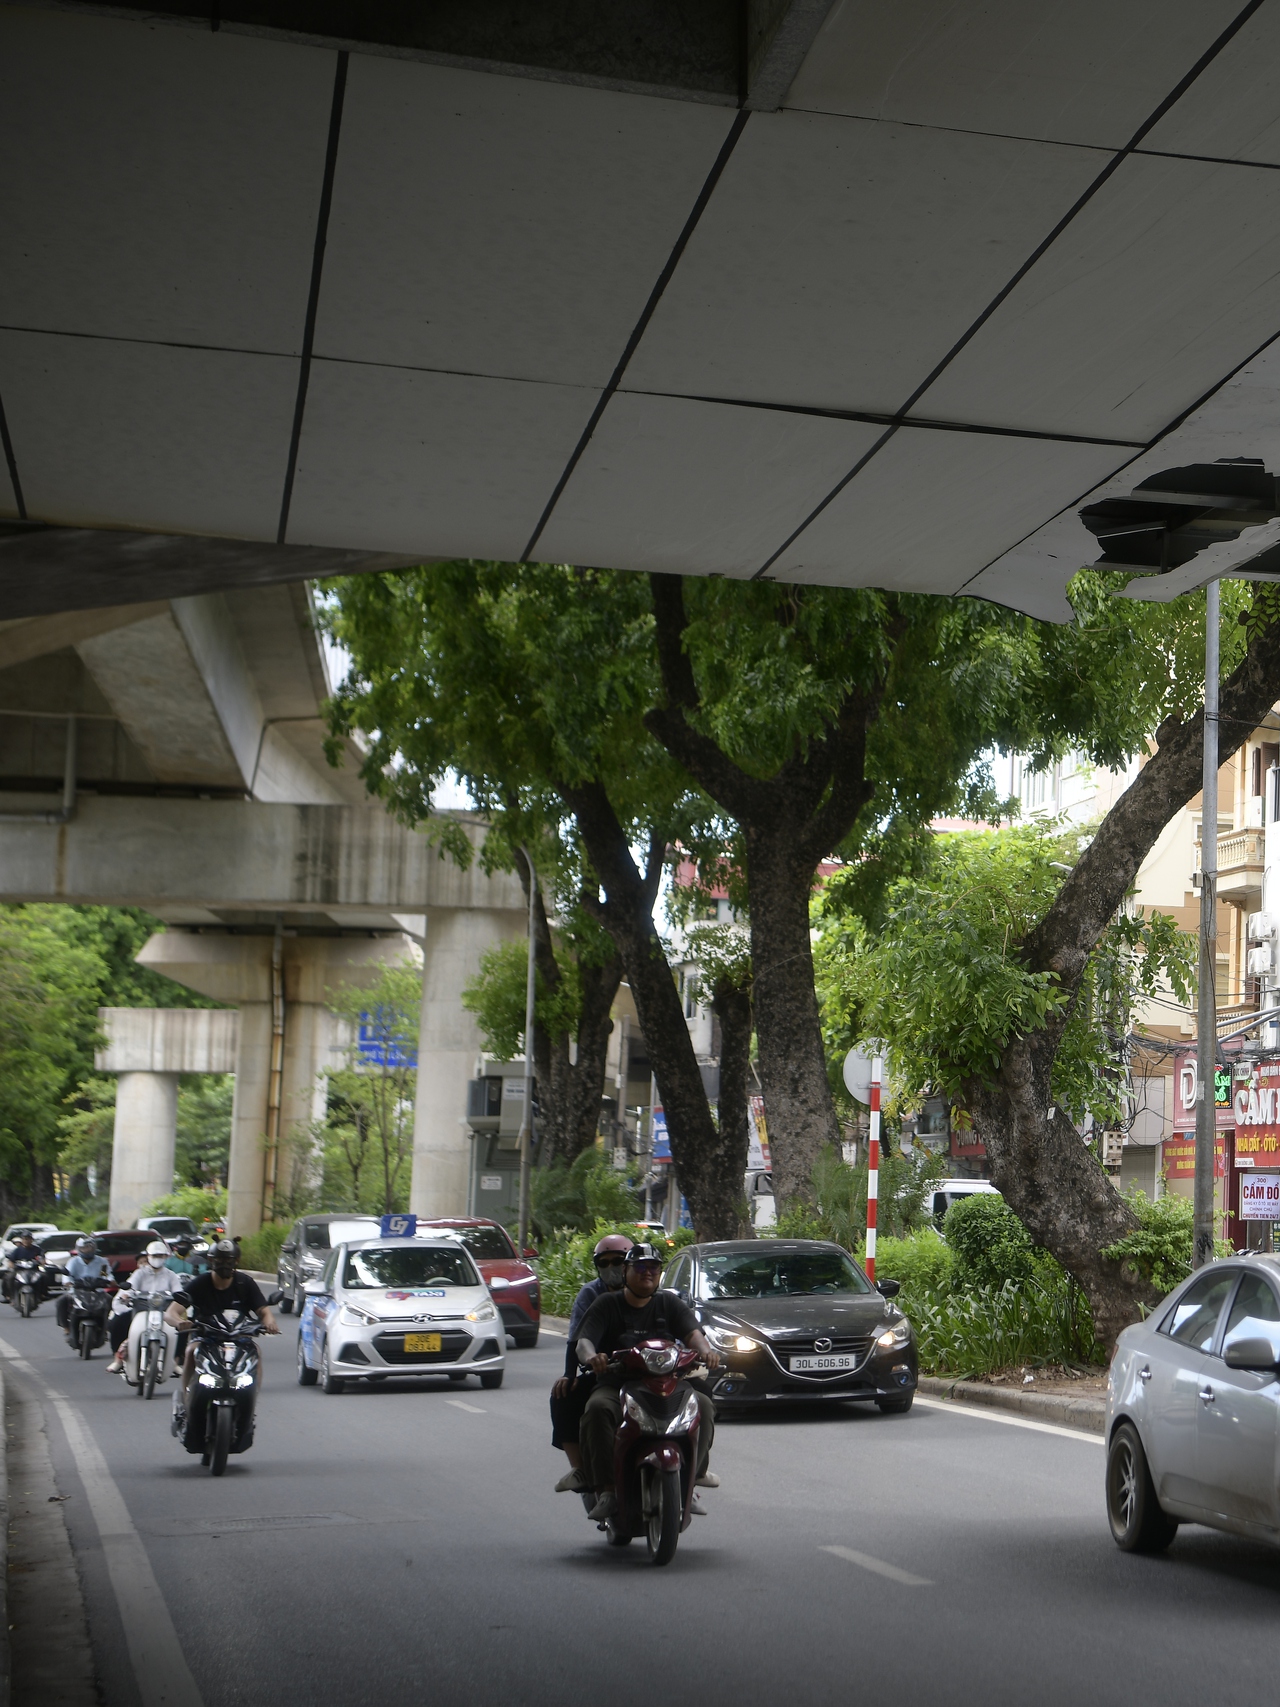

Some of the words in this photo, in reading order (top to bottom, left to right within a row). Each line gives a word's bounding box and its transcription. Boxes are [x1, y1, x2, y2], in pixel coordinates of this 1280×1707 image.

[1234, 1071, 1276, 1126] CẦM
[1237, 1134, 1248, 1152] NHÀ
[1249, 1131, 1260, 1152] ĐẤT
[1243, 1182, 1264, 1200] CẦM
[1267, 1182, 1279, 1200] ĐỒ
[412, 1290, 444, 1298] TAXI
[416, 1334, 431, 1343] 30E
[796, 1358, 850, 1369] 30L-606.96
